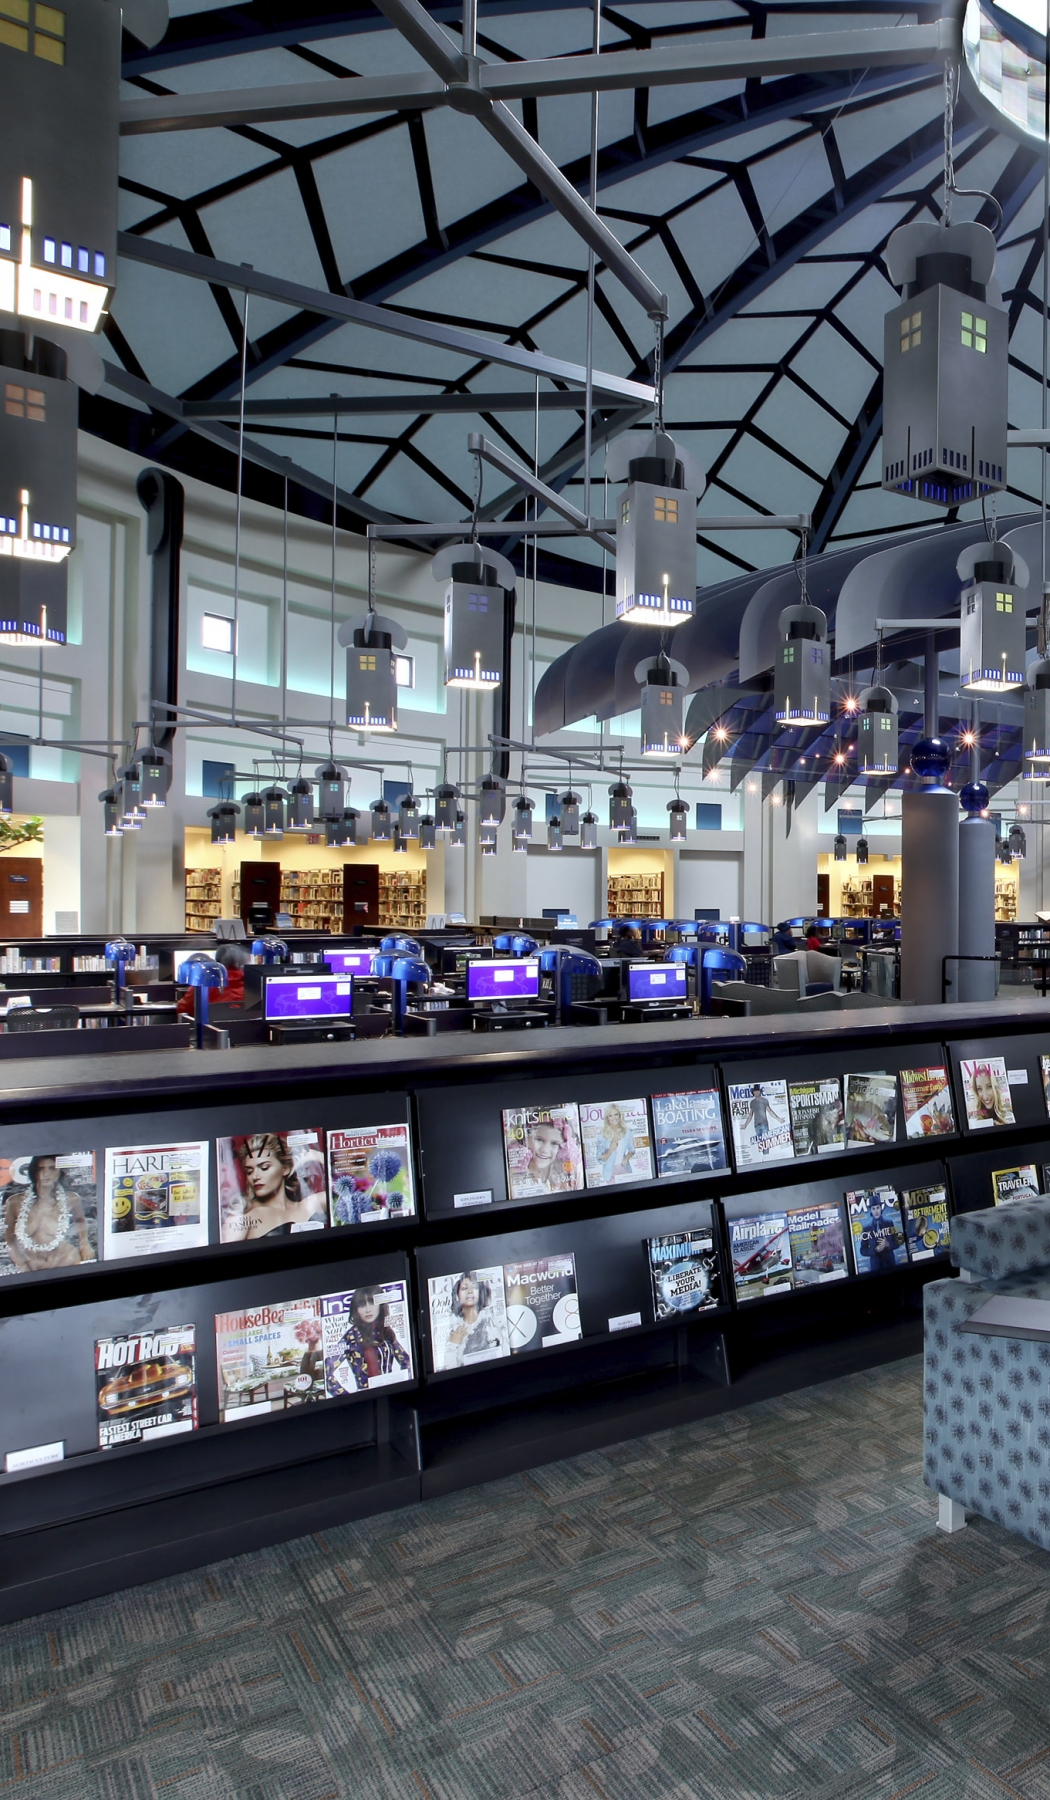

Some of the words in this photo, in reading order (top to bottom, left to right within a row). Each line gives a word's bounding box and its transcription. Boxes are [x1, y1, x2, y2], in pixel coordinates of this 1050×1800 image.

[901, 1070, 927, 1084] Midwest
[729, 1084, 754, 1100] Men's
[789, 1087, 815, 1095] Michigan
[655, 1094, 715, 1112] Lakelad
[790, 1090, 839, 1108] SPORTSMAN
[580, 1098, 648, 1123] Joul
[657, 1107, 716, 1125] BOATING
[732, 1107, 750, 1116] FAST!
[331, 1132, 406, 1149] Horticu
[507, 1127, 524, 1140] 40
[758, 1131, 792, 1152] SUMMER
[998, 1177, 1033, 1191] TRAVELER
[1012, 1193, 1034, 1201] PORTUGAL
[788, 1210, 819, 1224] Model
[913, 1203, 947, 1217] RETIREMENT
[229, 1218, 263, 1228] FASHION
[788, 1216, 841, 1232] Railroader
[932, 1212, 948, 1223] MOVE
[855, 1232, 872, 1241] JACK
[873, 1227, 891, 1239] WHITE
[733, 1240, 760, 1248] AMERICAN
[667, 1266, 702, 1283] LIBERATE
[675, 1276, 695, 1287] YOUR
[530, 1284, 555, 1296] Better
[670, 1280, 702, 1297] MEDIA!
[525, 1292, 562, 1305] Together
[227, 1337, 252, 1348] SMALL
[254, 1331, 281, 1343] SPACES
[97, 1338, 139, 1370] HOT
[99, 1422, 130, 1437] FASTEST
[131, 1416, 157, 1431] STREET
[158, 1413, 173, 1423] CAR
[99, 1434, 108, 1446] IN
[108, 1429, 142, 1444] AMERICA
